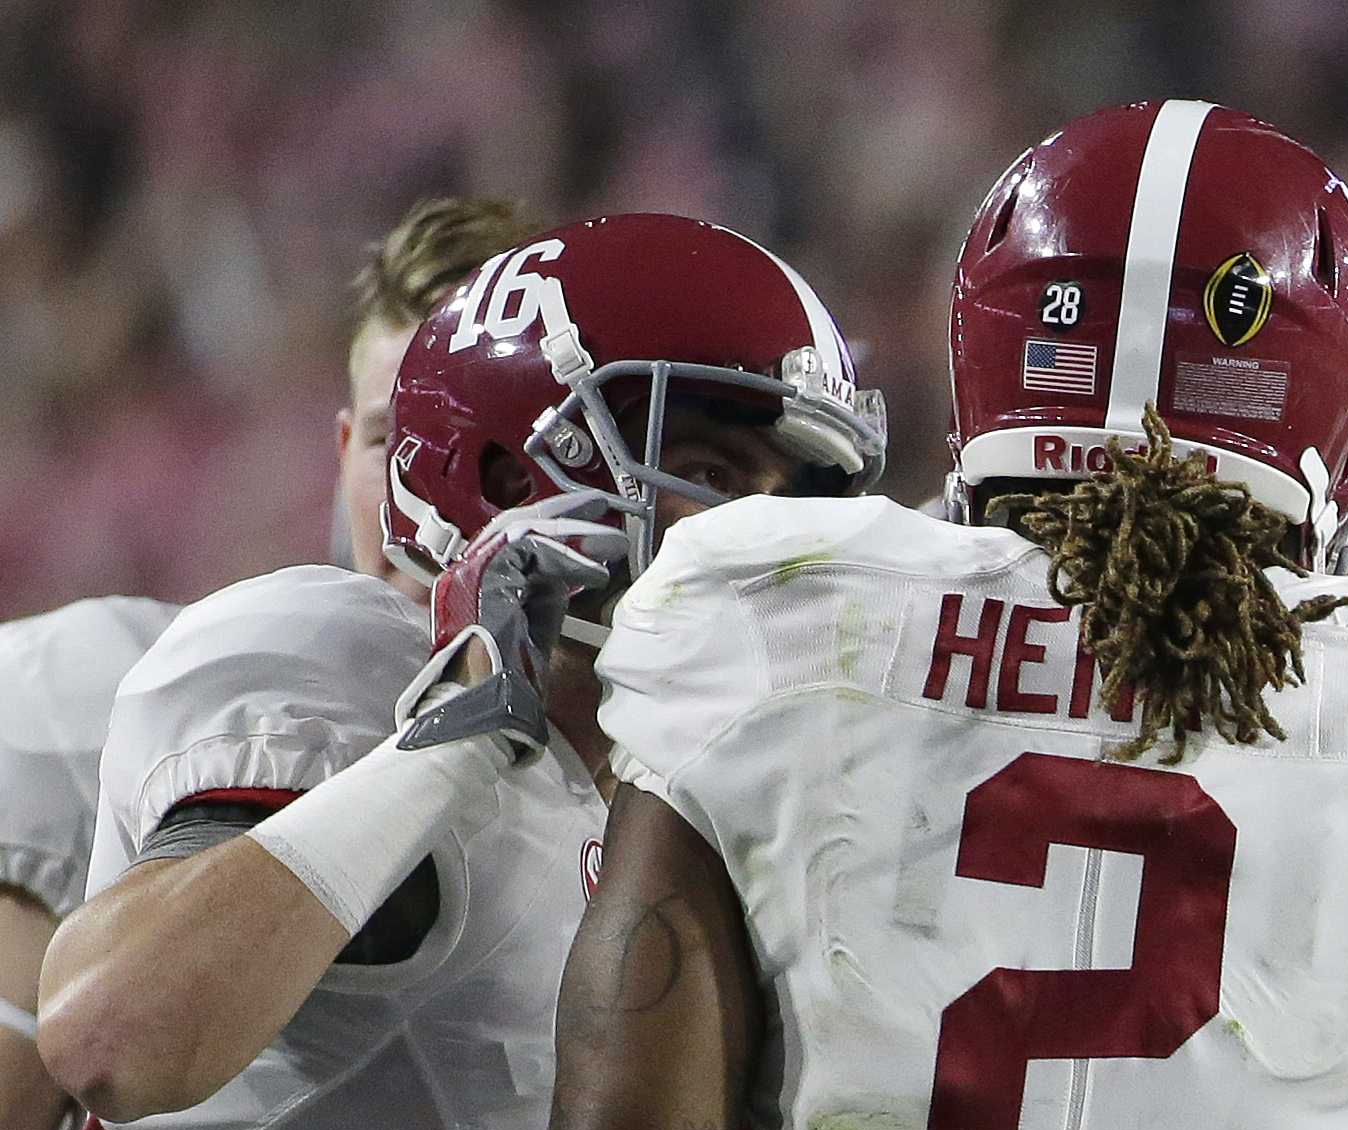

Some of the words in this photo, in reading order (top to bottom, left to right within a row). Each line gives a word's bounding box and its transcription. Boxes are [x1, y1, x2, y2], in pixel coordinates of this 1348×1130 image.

[448, 238, 566, 354] 16
[1042, 284, 1081, 325] 28
[1212, 356, 1260, 370] WARNING
